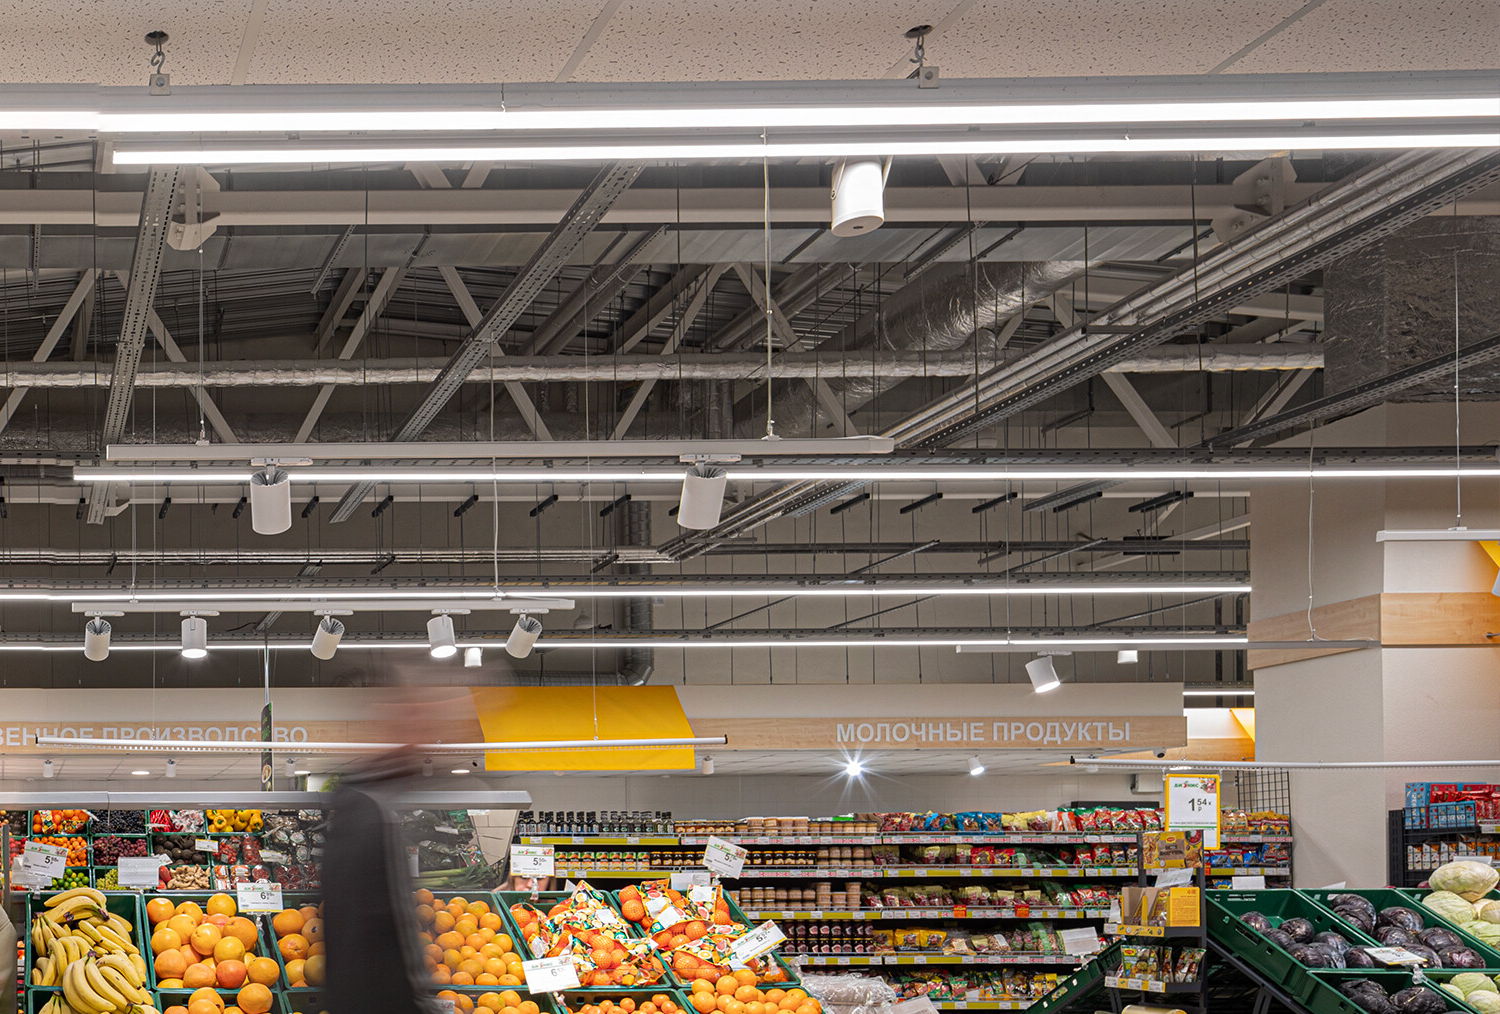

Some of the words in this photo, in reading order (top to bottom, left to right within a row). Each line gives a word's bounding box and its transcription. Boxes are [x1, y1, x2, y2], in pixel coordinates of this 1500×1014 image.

[103, 727, 308, 746] ПРОИЗВОДСВО
[836, 722, 984, 742] МОЛОЧНЫЕ
[992, 722, 1130, 744] ПРОДУКТЫ
[1188, 798, 1195, 811] 1
